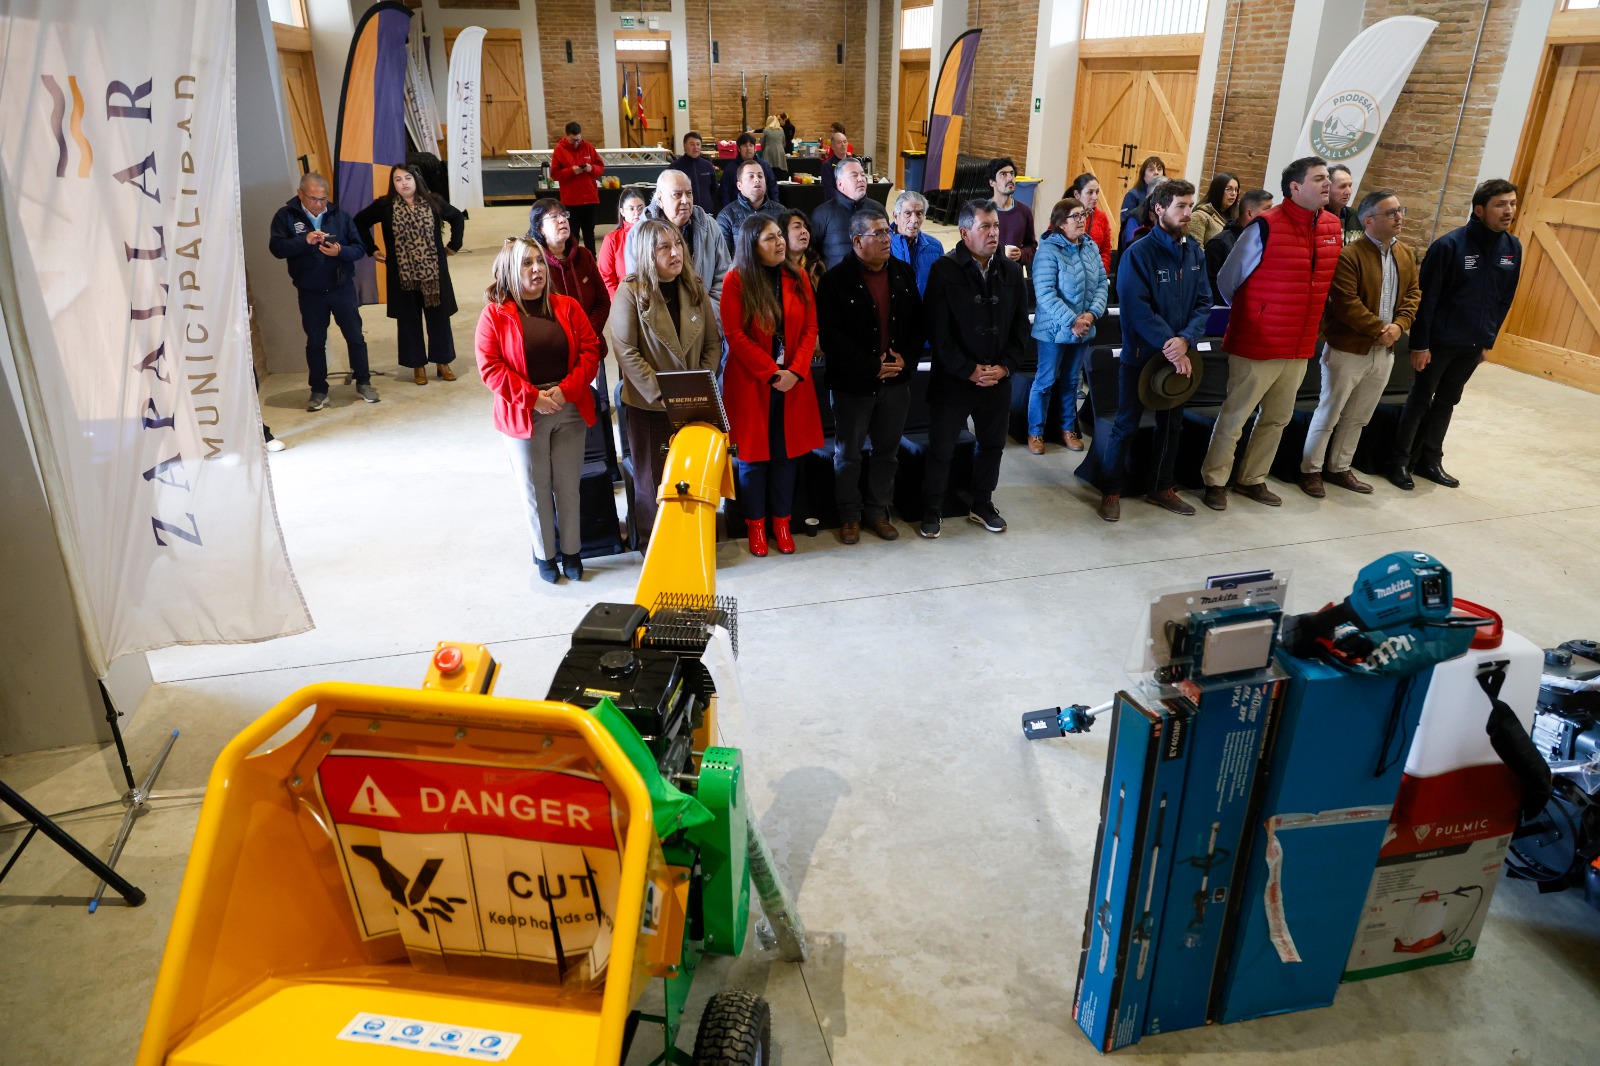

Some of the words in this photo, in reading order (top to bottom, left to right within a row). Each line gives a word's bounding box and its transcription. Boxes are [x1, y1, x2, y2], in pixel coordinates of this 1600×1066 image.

[1333, 93, 1374, 114] PRODESAL
[1313, 137, 1359, 158] ZAPALLAR
[419, 787, 593, 831] DANGER
[1435, 819, 1489, 837] PULMIC
[507, 869, 597, 901] CUT
[489, 911, 527, 928] Keep
